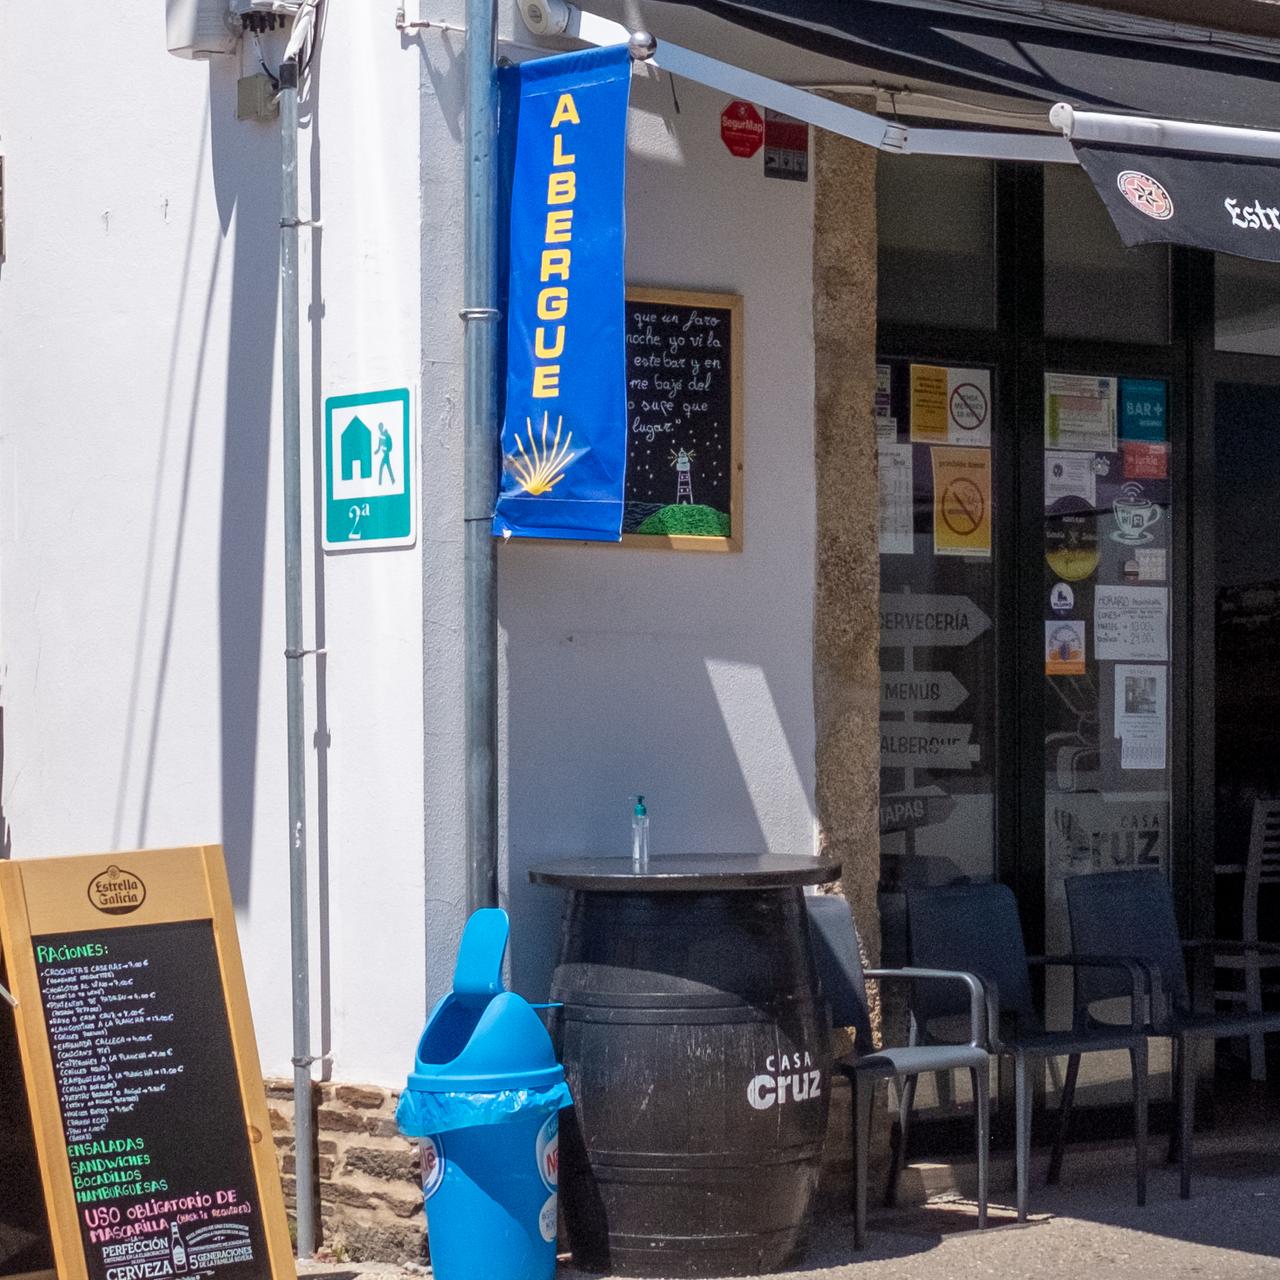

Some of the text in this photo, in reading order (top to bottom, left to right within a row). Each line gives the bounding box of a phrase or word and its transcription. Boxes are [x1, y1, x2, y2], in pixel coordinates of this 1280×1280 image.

[532, 93, 580, 399] ALBERGUE
[634, 310, 720, 331] que un faro
[627, 326, 721, 354] noche yo vi la
[634, 351, 720, 375] este bar y en
[630, 378, 648, 390] me
[688, 372, 711, 391] del
[641, 400, 674, 416] supe
[683, 401, 708, 418] que
[885, 678, 941, 701] MENÚS
[1120, 813, 1159, 829] CASA
[96, 879, 138, 893] Estrella
[99, 891, 138, 905] Galicia
[766, 1051, 811, 1071] CASA
[67, 1137, 145, 1157] ENSALADAS
[76, 1179, 169, 1204] HAMBURGUESAS
[84, 1207, 121, 1228] USO
[216, 1189, 238, 1204] DE
[102, 1235, 170, 1258] PERFECCIÓN
[106, 1260, 173, 1280] CERVEZA
[189, 1254, 199, 1269] 5
